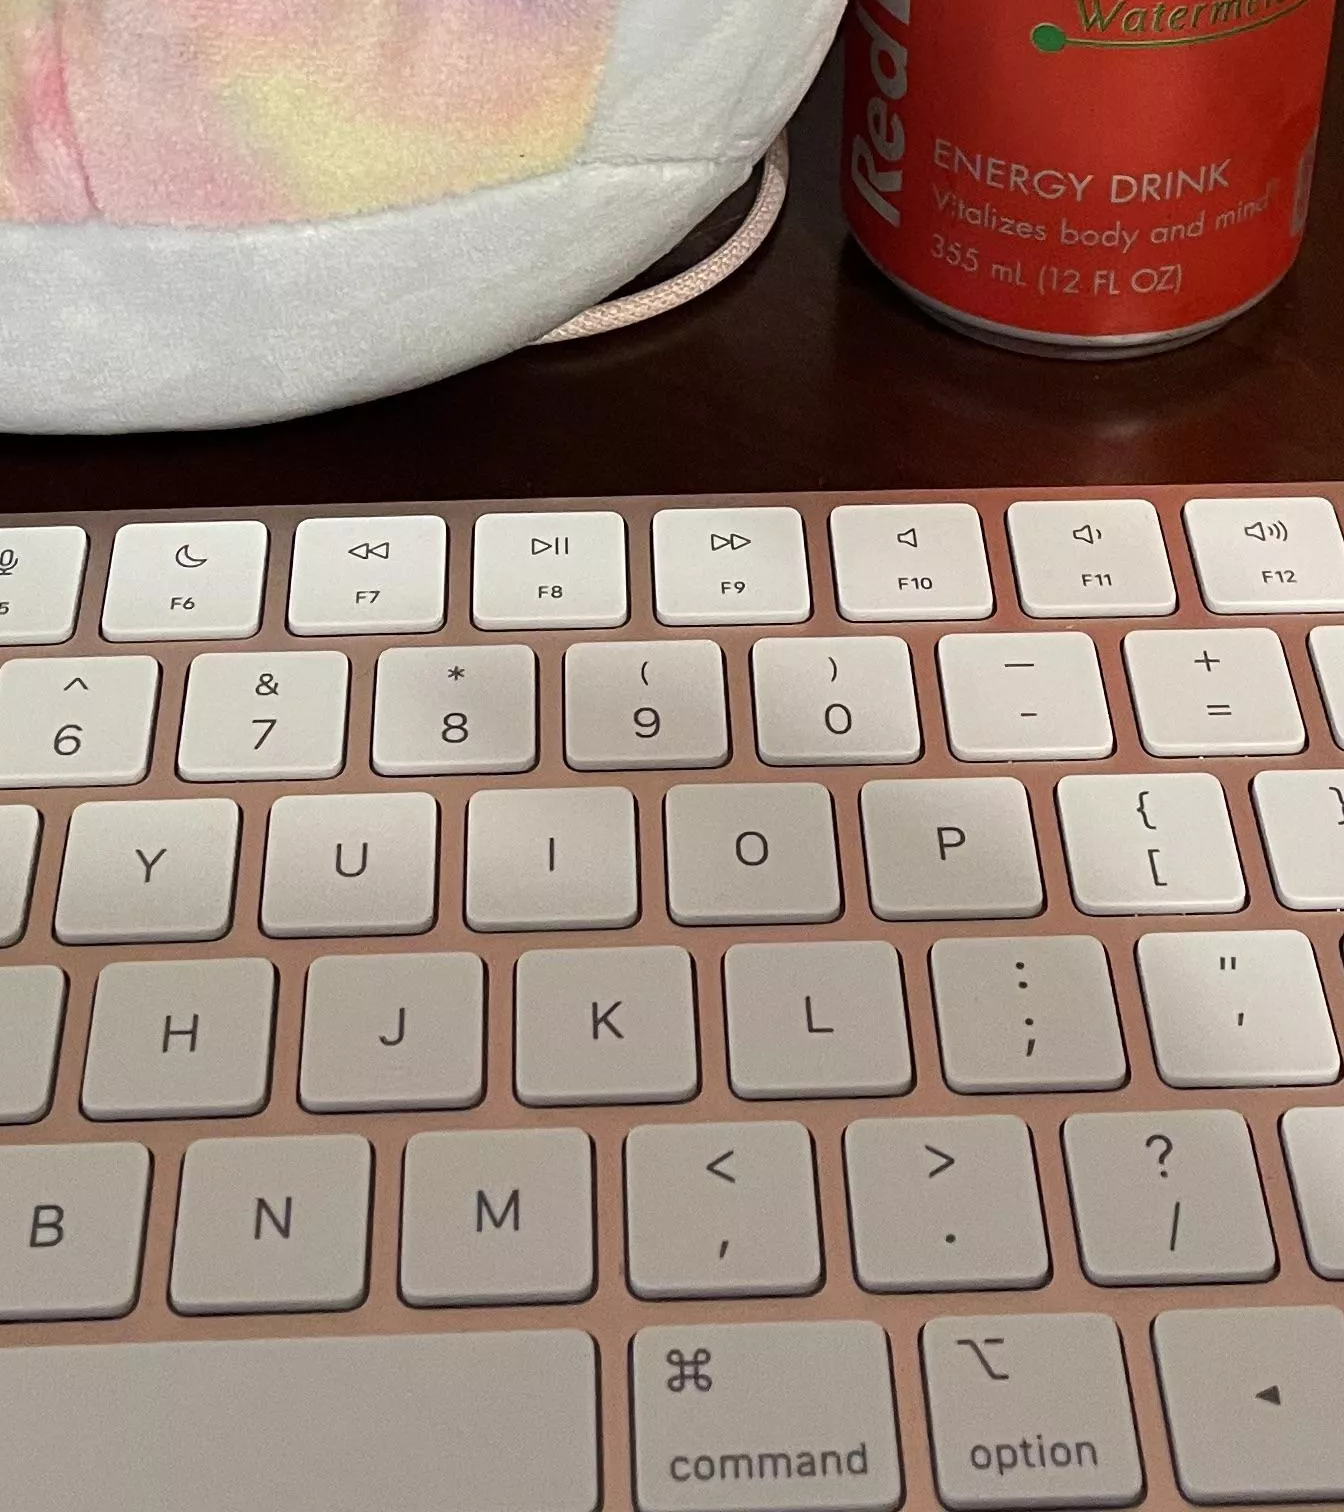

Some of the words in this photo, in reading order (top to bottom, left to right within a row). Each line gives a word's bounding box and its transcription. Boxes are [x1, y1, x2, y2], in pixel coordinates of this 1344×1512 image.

[933, 138, 1094, 202] ENERGY
[1110, 158, 1231, 204] DRINK
[932, 185, 1046, 241] Vitalizes
[1060, 218, 1140, 254] body
[1150, 211, 1205, 243] and
[931, 234, 980, 273] 355
[1038, 265, 1080, 295] (12
[1092, 270, 1120, 296] FL
[1131, 263, 1183, 295] OZ)
[538, 585, 563, 599] F8
[720, 580, 746, 595] F9
[897, 577, 933, 590] F10
[1081, 573, 1112, 587] F11
[1261, 569, 1297, 584] F12
[170, 596, 196, 611] F6
[355, 590, 381, 604] F7
[640, 661, 649, 686] (
[828, 656, 838, 683] )
[1194, 650, 1221, 673] +
[254, 672, 279, 697] &
[633, 707, 661, 739] 9
[824, 703, 853, 735] 0
[1206, 704, 1232, 716] =
[53, 724, 83, 756] 6
[251, 718, 277, 750] 7
[441, 712, 469, 744] 8
[1136, 790, 1157, 830] {
[335, 842, 369, 878] U
[548, 837, 555, 872] I
[735, 830, 769, 867] O
[936, 826, 966, 861] P
[135, 848, 167, 884] Y
[1147, 848, 1168, 887] [
[1015, 961, 1028, 990] :
[379, 1007, 406, 1047] J
[591, 1000, 624, 1041] K
[804, 995, 835, 1034] L
[161, 1013, 199, 1054] H
[1024, 1017, 1036, 1057] ;
[705, 1150, 736, 1184] <
[924, 1144, 956, 1179] >
[1145, 1134, 1173, 1179] ?
[29, 1204, 65, 1248] B
[253, 1196, 293, 1240] N
[476, 1188, 520, 1233] M
[1169, 1201, 1181, 1252] /
[669, 1442, 869, 1483] command
[970, 1433, 1098, 1477] option
